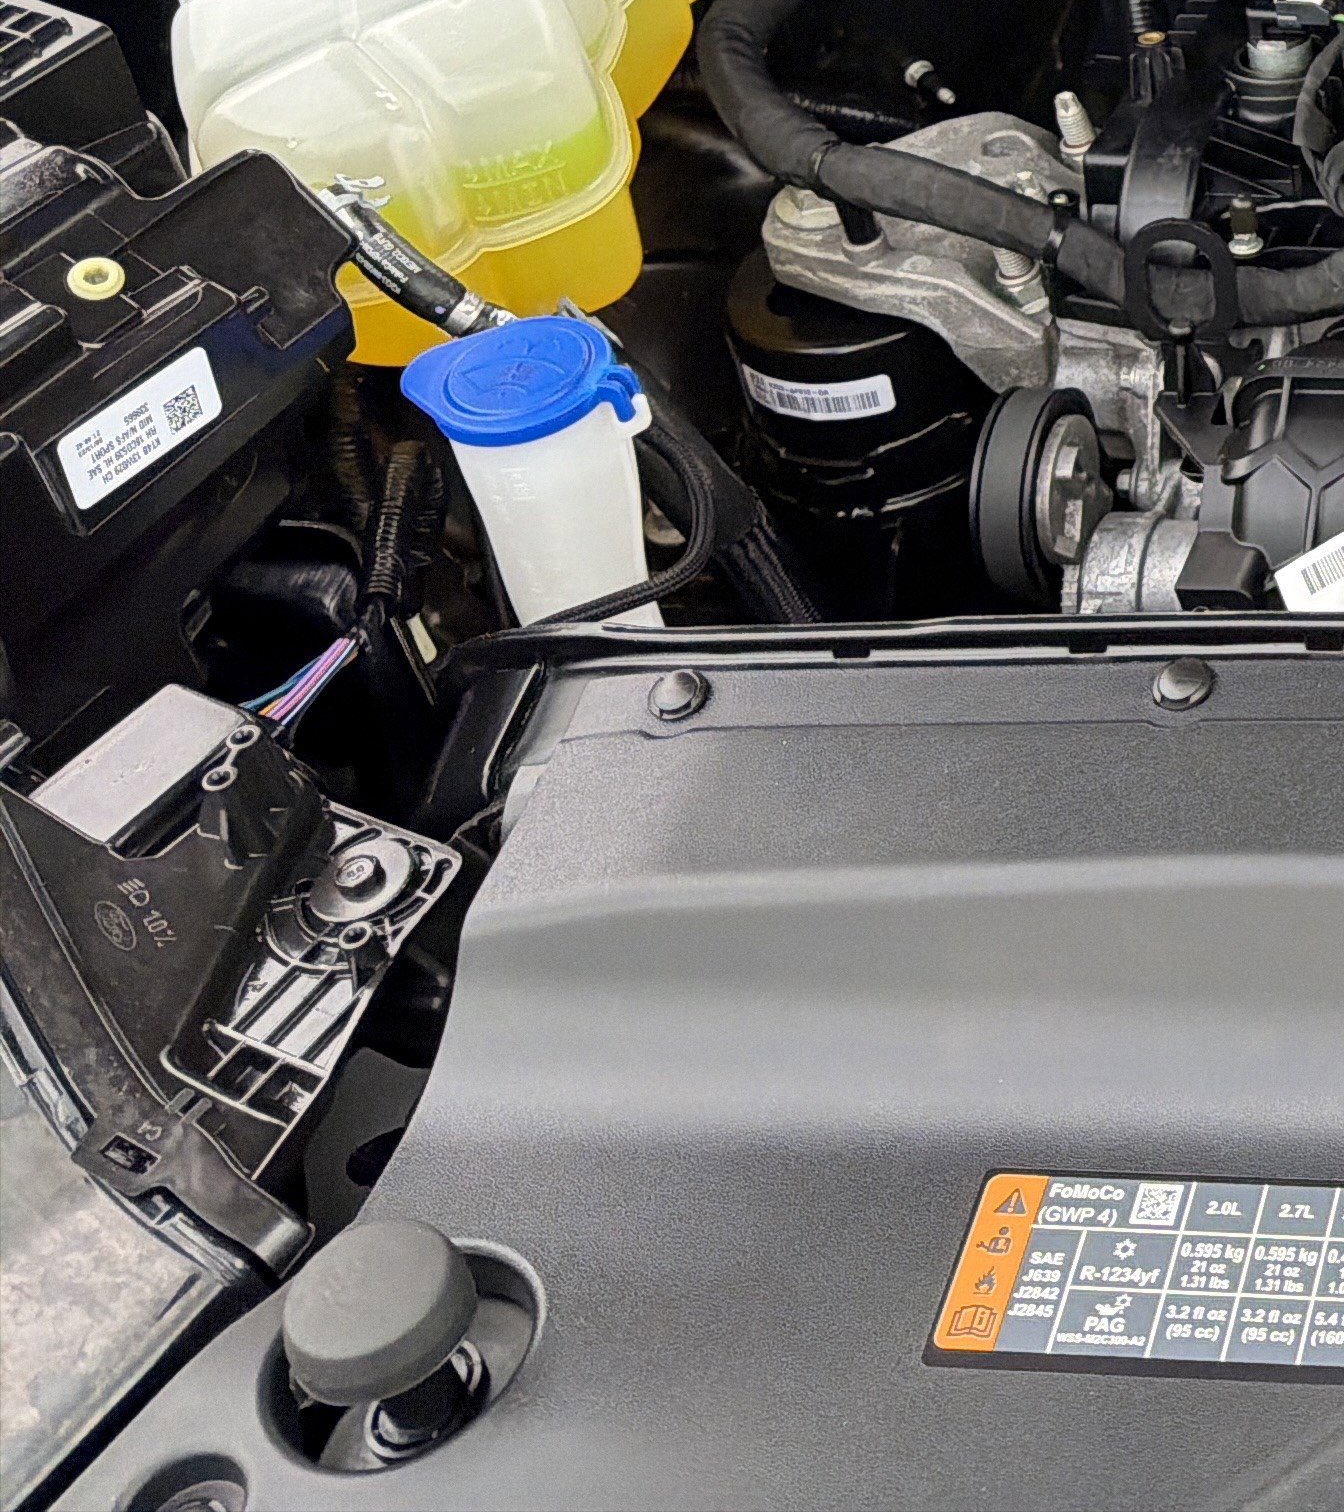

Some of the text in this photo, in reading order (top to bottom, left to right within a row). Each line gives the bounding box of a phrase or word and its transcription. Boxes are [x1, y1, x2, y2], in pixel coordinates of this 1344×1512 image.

[87, 440, 115, 463] SPORT
[85, 464, 103, 480] SAE
[1049, 1183, 1125, 1201] FoMoCo
[1038, 1206, 1117, 1226] (GWP 4)
[1206, 1200, 1242, 1216] 2.0L
[1278, 1204, 1315, 1220] 2.7L
[1030, 1252, 1066, 1265] SAE
[1181, 1243, 1244, 1264] 0.595 kg
[1255, 1247, 1317, 1267] 0.595 kg
[1022, 1269, 1060, 1282] J639
[1190, 1261, 1226, 1274] 21 oz
[1263, 1265, 1300, 1277] 21 oz
[1080, 1266, 1160, 1286] R-1234yf
[1181, 1275, 1229, 1290] 1.31 lbs
[1014, 1287, 1060, 1300] J2842
[1255, 1279, 1304, 1293] 1.31 lbs
[1008, 1305, 1054, 1317] J2845
[1166, 1305, 1190, 1319] 3.2
[1206, 1309, 1227, 1321] oz
[1241, 1309, 1265, 1323] 3.2
[1281, 1313, 1302, 1324] oz
[1315, 1312, 1339, 1326] 5.4
[1084, 1316, 1126, 1333] PAG
[1167, 1323, 1220, 1341] (95 cc)
[1242, 1326, 1294, 1344] (95 cc)
[1311, 1329, 1344, 1346] (160
